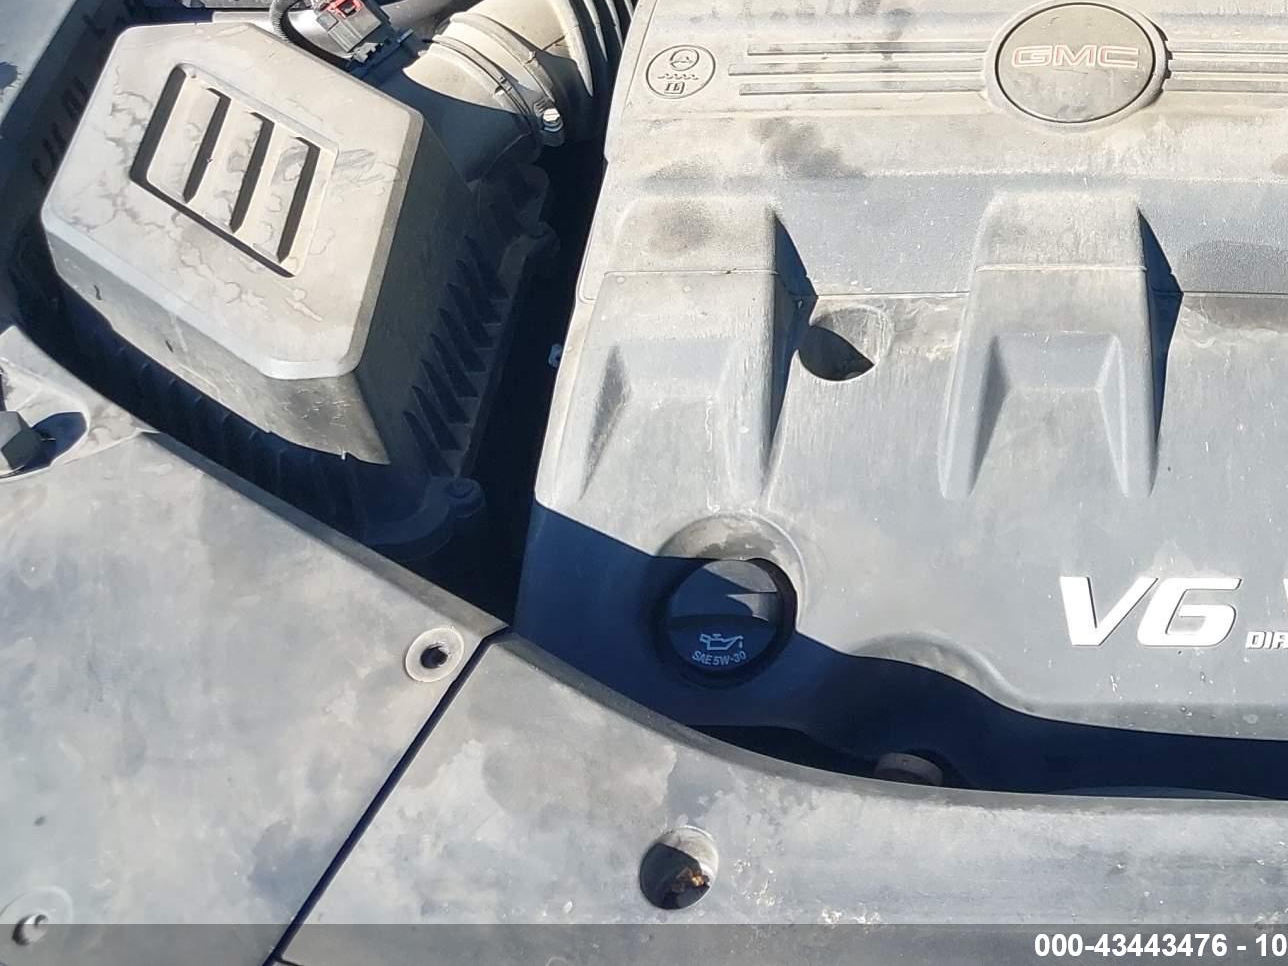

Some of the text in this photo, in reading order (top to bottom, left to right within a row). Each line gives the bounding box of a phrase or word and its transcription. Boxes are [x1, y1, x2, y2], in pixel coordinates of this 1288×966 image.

[1011, 44, 1138, 68] GMC
[1059, 575, 1242, 648] V6
[692, 650, 746, 666] SAE 5W-30
